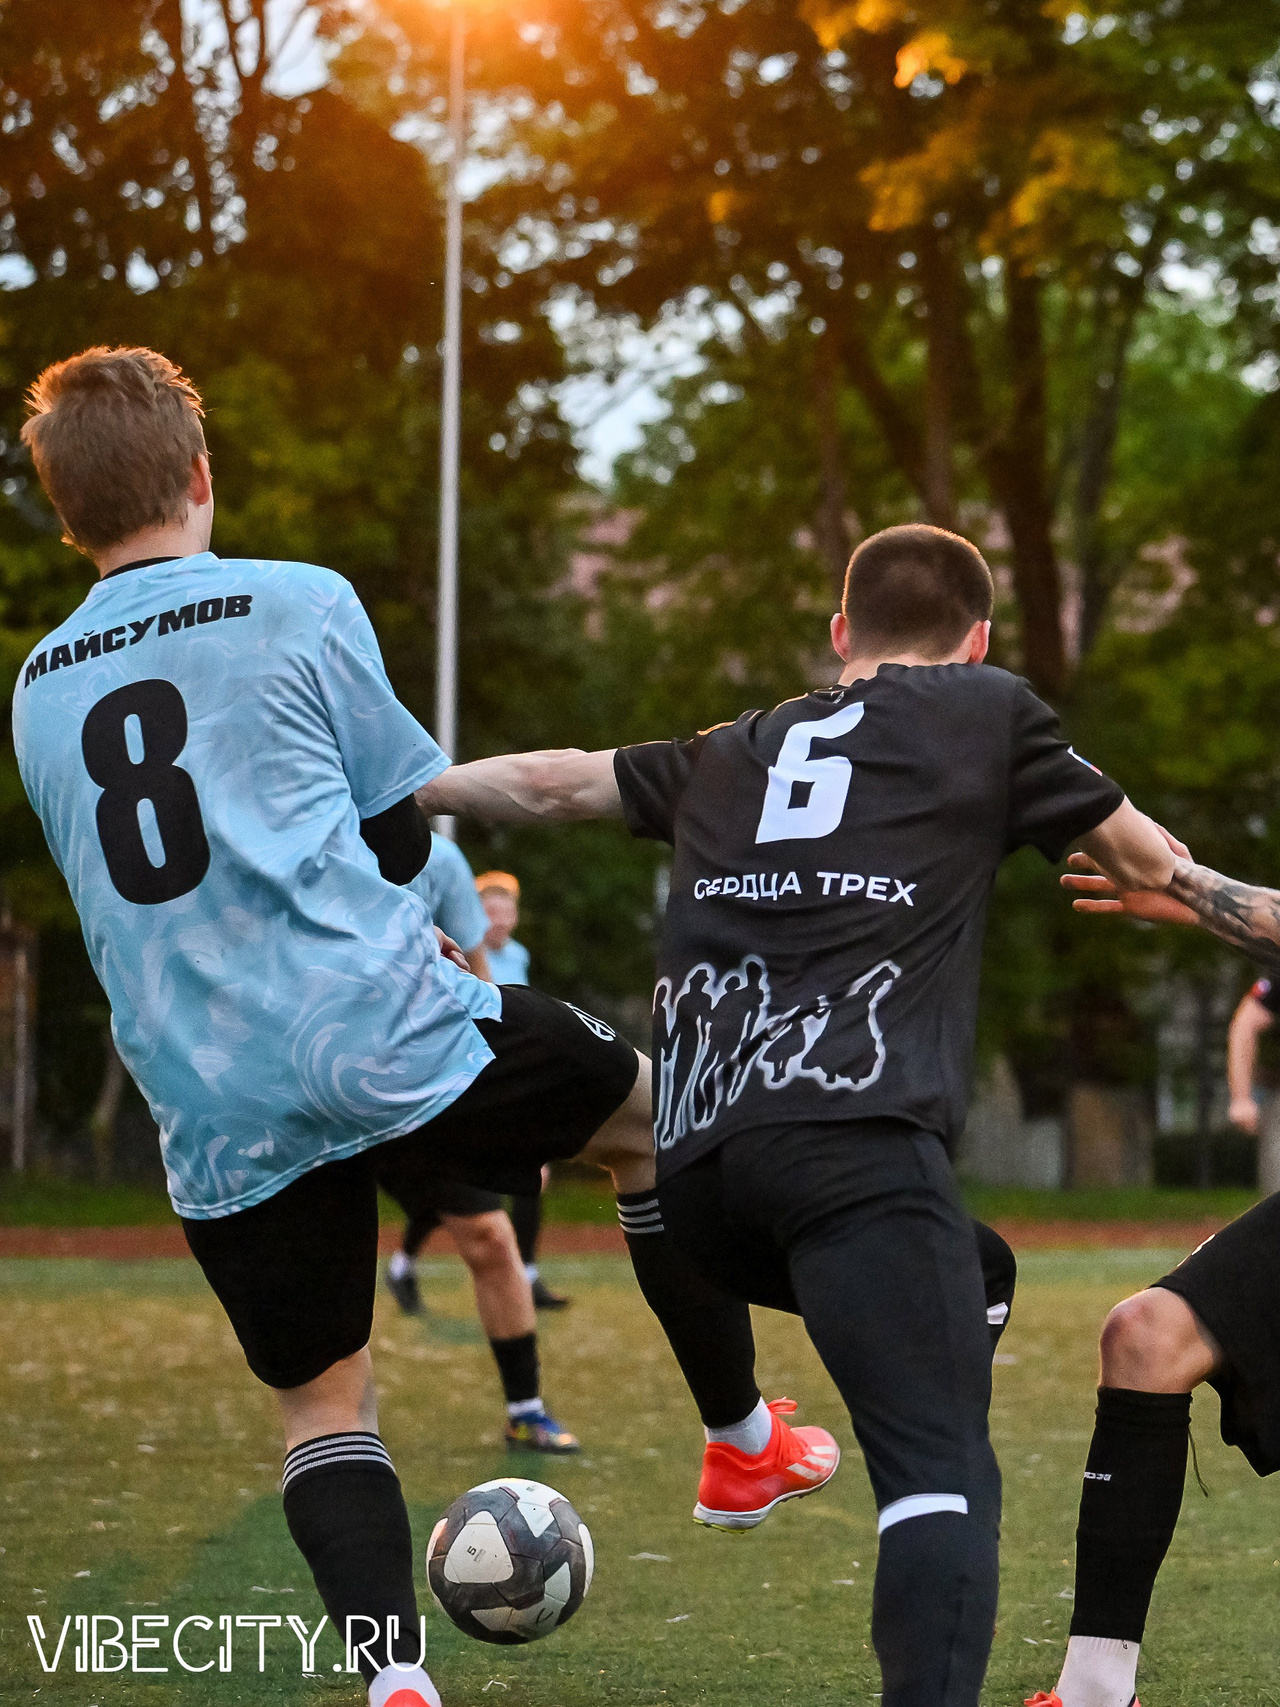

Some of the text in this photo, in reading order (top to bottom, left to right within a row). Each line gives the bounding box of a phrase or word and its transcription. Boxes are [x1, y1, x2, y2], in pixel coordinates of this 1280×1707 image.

[24, 594, 253, 688] МАЙСУМОВ
[81, 678, 211, 905] 8
[755, 701, 865, 844] 6
[694, 871, 918, 907] СЕРДЦА ТРЕХ
